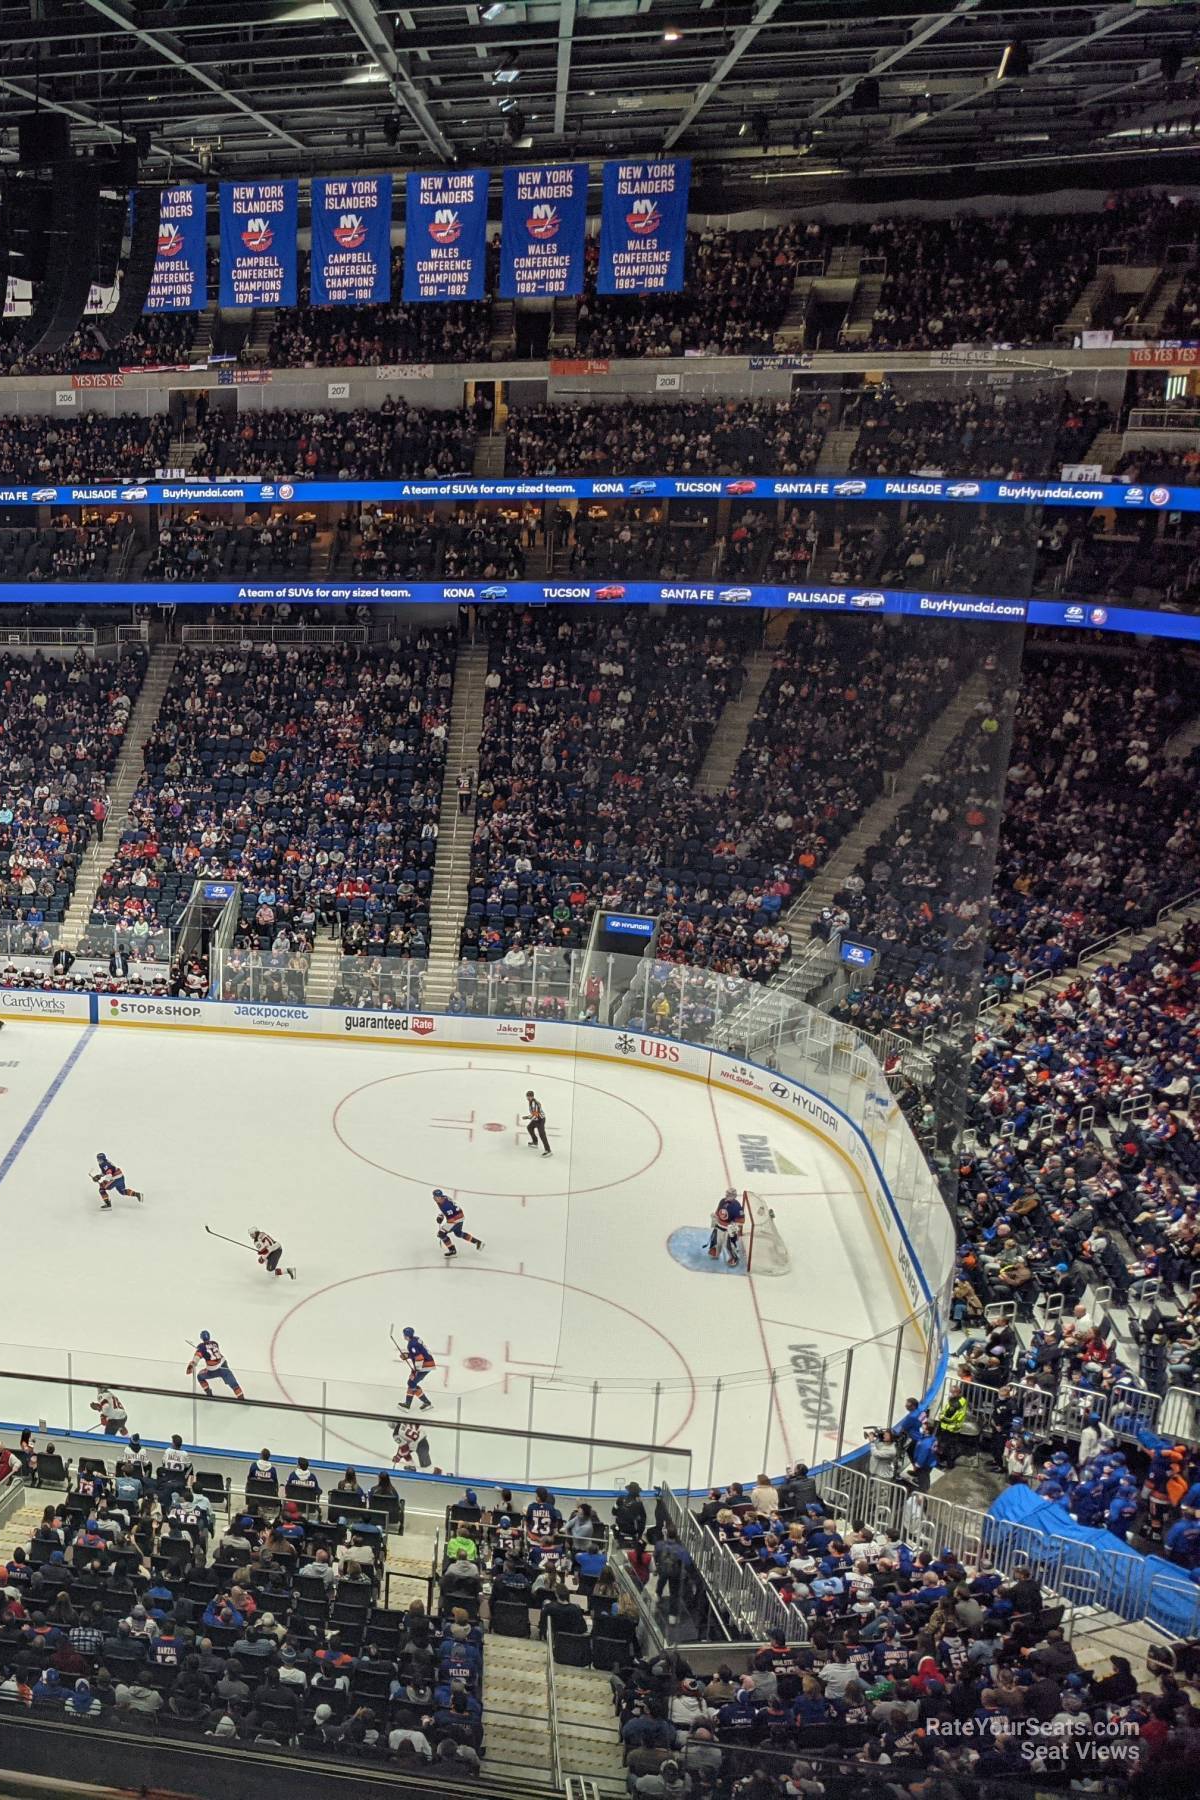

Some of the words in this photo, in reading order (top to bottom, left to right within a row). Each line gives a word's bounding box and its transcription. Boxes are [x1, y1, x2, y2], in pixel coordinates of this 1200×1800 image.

[518, 171, 541, 185] NEW
[546, 169, 574, 183] YORK
[618, 166, 641, 180] NEW
[647, 164, 676, 178] YORK
[325, 183, 347, 196] NEW
[351, 180, 378, 194] YORK
[420, 177, 443, 190] NEW
[447, 175, 474, 189] YORK
[617, 179, 675, 195] ISLANDERS
[168, 190, 192, 204] YORK
[233, 187, 255, 200] NEW
[258, 185, 284, 199] YORK
[420, 190, 474, 205] ISLANDERS
[517, 185, 573, 200] ISLANDERS
[233, 200, 284, 214] ISLANDERS
[325, 195, 378, 210] ISLANDERS
[528, 243, 558, 255] WALES
[627, 239, 658, 251] WALES
[328, 252, 372, 264] CAMPBELL
[430, 248, 459, 259] WALES
[612, 251, 671, 264] CONFERENCE
[236, 256, 279, 267] CAMPBELL
[417, 259, 472, 272] CONFERENCE
[514, 255, 571, 268] CONFERENCE
[231, 268, 284, 280] CONFERENCE
[323, 264, 377, 277] CONFERENCE
[515, 268, 567, 281] CHAMPIONS
[614, 264, 668, 277] CHAMPIONS
[325, 276, 374, 289] CHAMPIONS
[419, 272, 469, 284] CHAMPIONS
[233, 280, 282, 292] CHAMPIONS
[1154, 349, 1173, 361] YES
[1177, 348, 1198, 360] YES
[75, 375, 91, 387] YES
[91, 375, 107, 386] YES
[108, 374, 123, 386] YES
[660, 377, 676, 387] 208
[331, 387, 346, 396] 207
[58, 394, 73, 403] 206
[72, 489, 117, 499] PALISADE
[162, 487, 244, 500] BuyHyundai.com
[402, 485, 411, 495] A
[412, 485, 438, 495] team
[439, 485, 450, 495] of
[452, 484, 478, 494] SUVs
[480, 484, 493, 494] for
[495, 486, 514, 496] any
[515, 483, 542, 493] sized
[544, 483, 576, 493] team.
[592, 483, 624, 493] KONA
[675, 482, 721, 493] TUCSON
[774, 483, 811, 493] SANTA
[813, 484, 828, 493] FE
[885, 483, 942, 494] PALISADE
[998, 486, 1104, 500] BuyHyundai.com
[16, 491, 28, 500] FE
[443, 588, 475, 598] KONA
[543, 588, 590, 598] TUCSON
[660, 589, 698, 600] SANTA
[699, 589, 714, 600] FE
[788, 592, 845, 604] PALISADE
[920, 599, 1025, 616] BuyHyundai.com
[2, 993, 66, 1011] CardWorks
[120, 1002, 200, 1017] STOP&SHOP
[234, 1005, 309, 1020] Jackpocket
[252, 1018, 274, 1028] Lottery
[275, 1020, 289, 1028] App
[345, 1013, 409, 1031] guaranteed
[412, 1018, 434, 1030] Rate
[639, 1038, 680, 1063] UBS
[791, 1091, 839, 1133] HYUNDAI
[738, 1133, 778, 1175] DIME
[788, 1343, 840, 1432] verizon
[531, 1516, 552, 1535] 13
